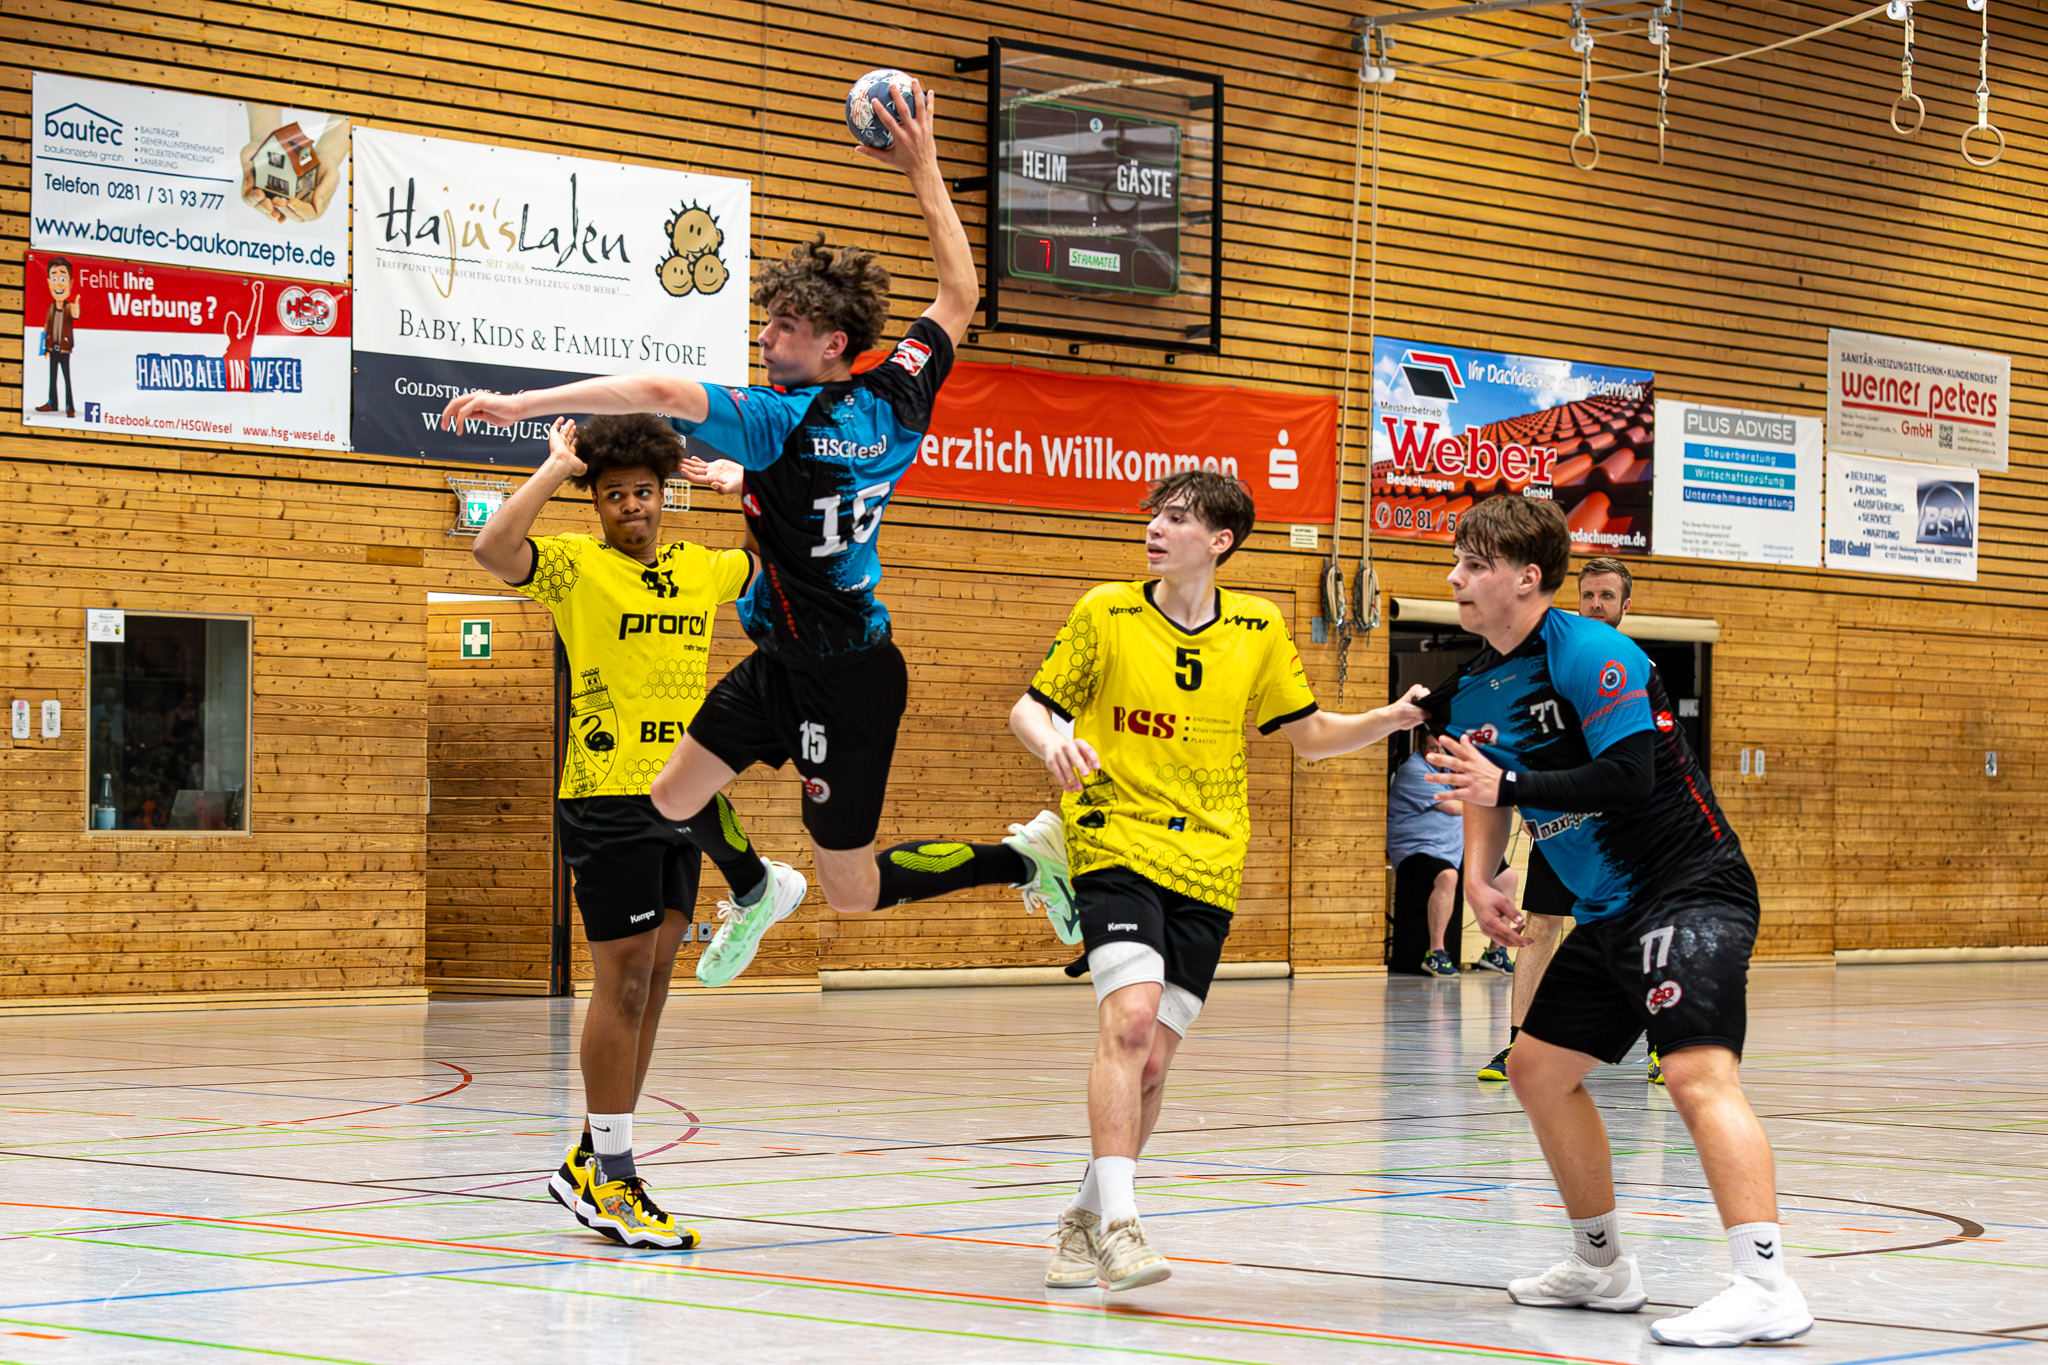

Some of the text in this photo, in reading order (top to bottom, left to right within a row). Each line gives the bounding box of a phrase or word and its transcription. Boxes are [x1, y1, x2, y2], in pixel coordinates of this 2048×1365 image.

[45, 114, 123, 146] bautec
[140, 125, 180, 138] BAUTRÄGER
[44, 144, 124, 162] baukonzepte gmbh
[1022, 150, 1172, 199] HEIM GÄSTE
[45, 173, 225, 210] Telefon 0281 / 31 93 777
[35, 216, 336, 267] www.bautec-baukonzepte.de
[1071, 251, 1119, 270] STRAMATEL
[79, 269, 154, 291] Fehlt Ihre
[107, 292, 218, 326] Werbung ?
[286, 296, 330, 319] HSG
[398, 308, 707, 367] BABY, KIDS & FAMILY STORE
[136, 356, 302, 391] HANDBALL IN WESEL
[1468, 360, 1486, 382] Ihr
[1841, 371, 1998, 418] werner peters
[1379, 401, 1443, 418] Meisterbetrieb
[104, 411, 336, 443] facebook.com/HSGWesel www.hsg-wesel.de
[1687, 413, 1794, 442] PLUS ADVISE
[1901, 419, 1933, 439] GmbH
[911, 427, 1032, 475] erzlich
[1380, 415, 1558, 485] Weber
[1703, 446, 1777, 467] Steuerberatung
[1386, 472, 1455, 492] Bedachungen
[1694, 468, 1785, 489] Wirtschaftsprüfung
[1522, 486, 1554, 500] GmbH
[1684, 488, 1794, 511] Unternehmensberatung
[810, 481, 891, 557] 15
[1395, 506, 1413, 528] 02
[1416, 508, 1433, 531] 81
[1447, 512, 1457, 533] 5
[1862, 513, 1892, 525] SERVICE
[1924, 505, 1966, 539] BSH
[1569, 527, 1647, 548] edachungen.de
[1174, 646, 1203, 692] 5
[1529, 698, 1566, 734] 77
[799, 719, 828, 764] 15
[630, 909, 656, 924] Kempa
[1107, 921, 1138, 933] Kempa
[1639, 925, 1675, 975] 77
